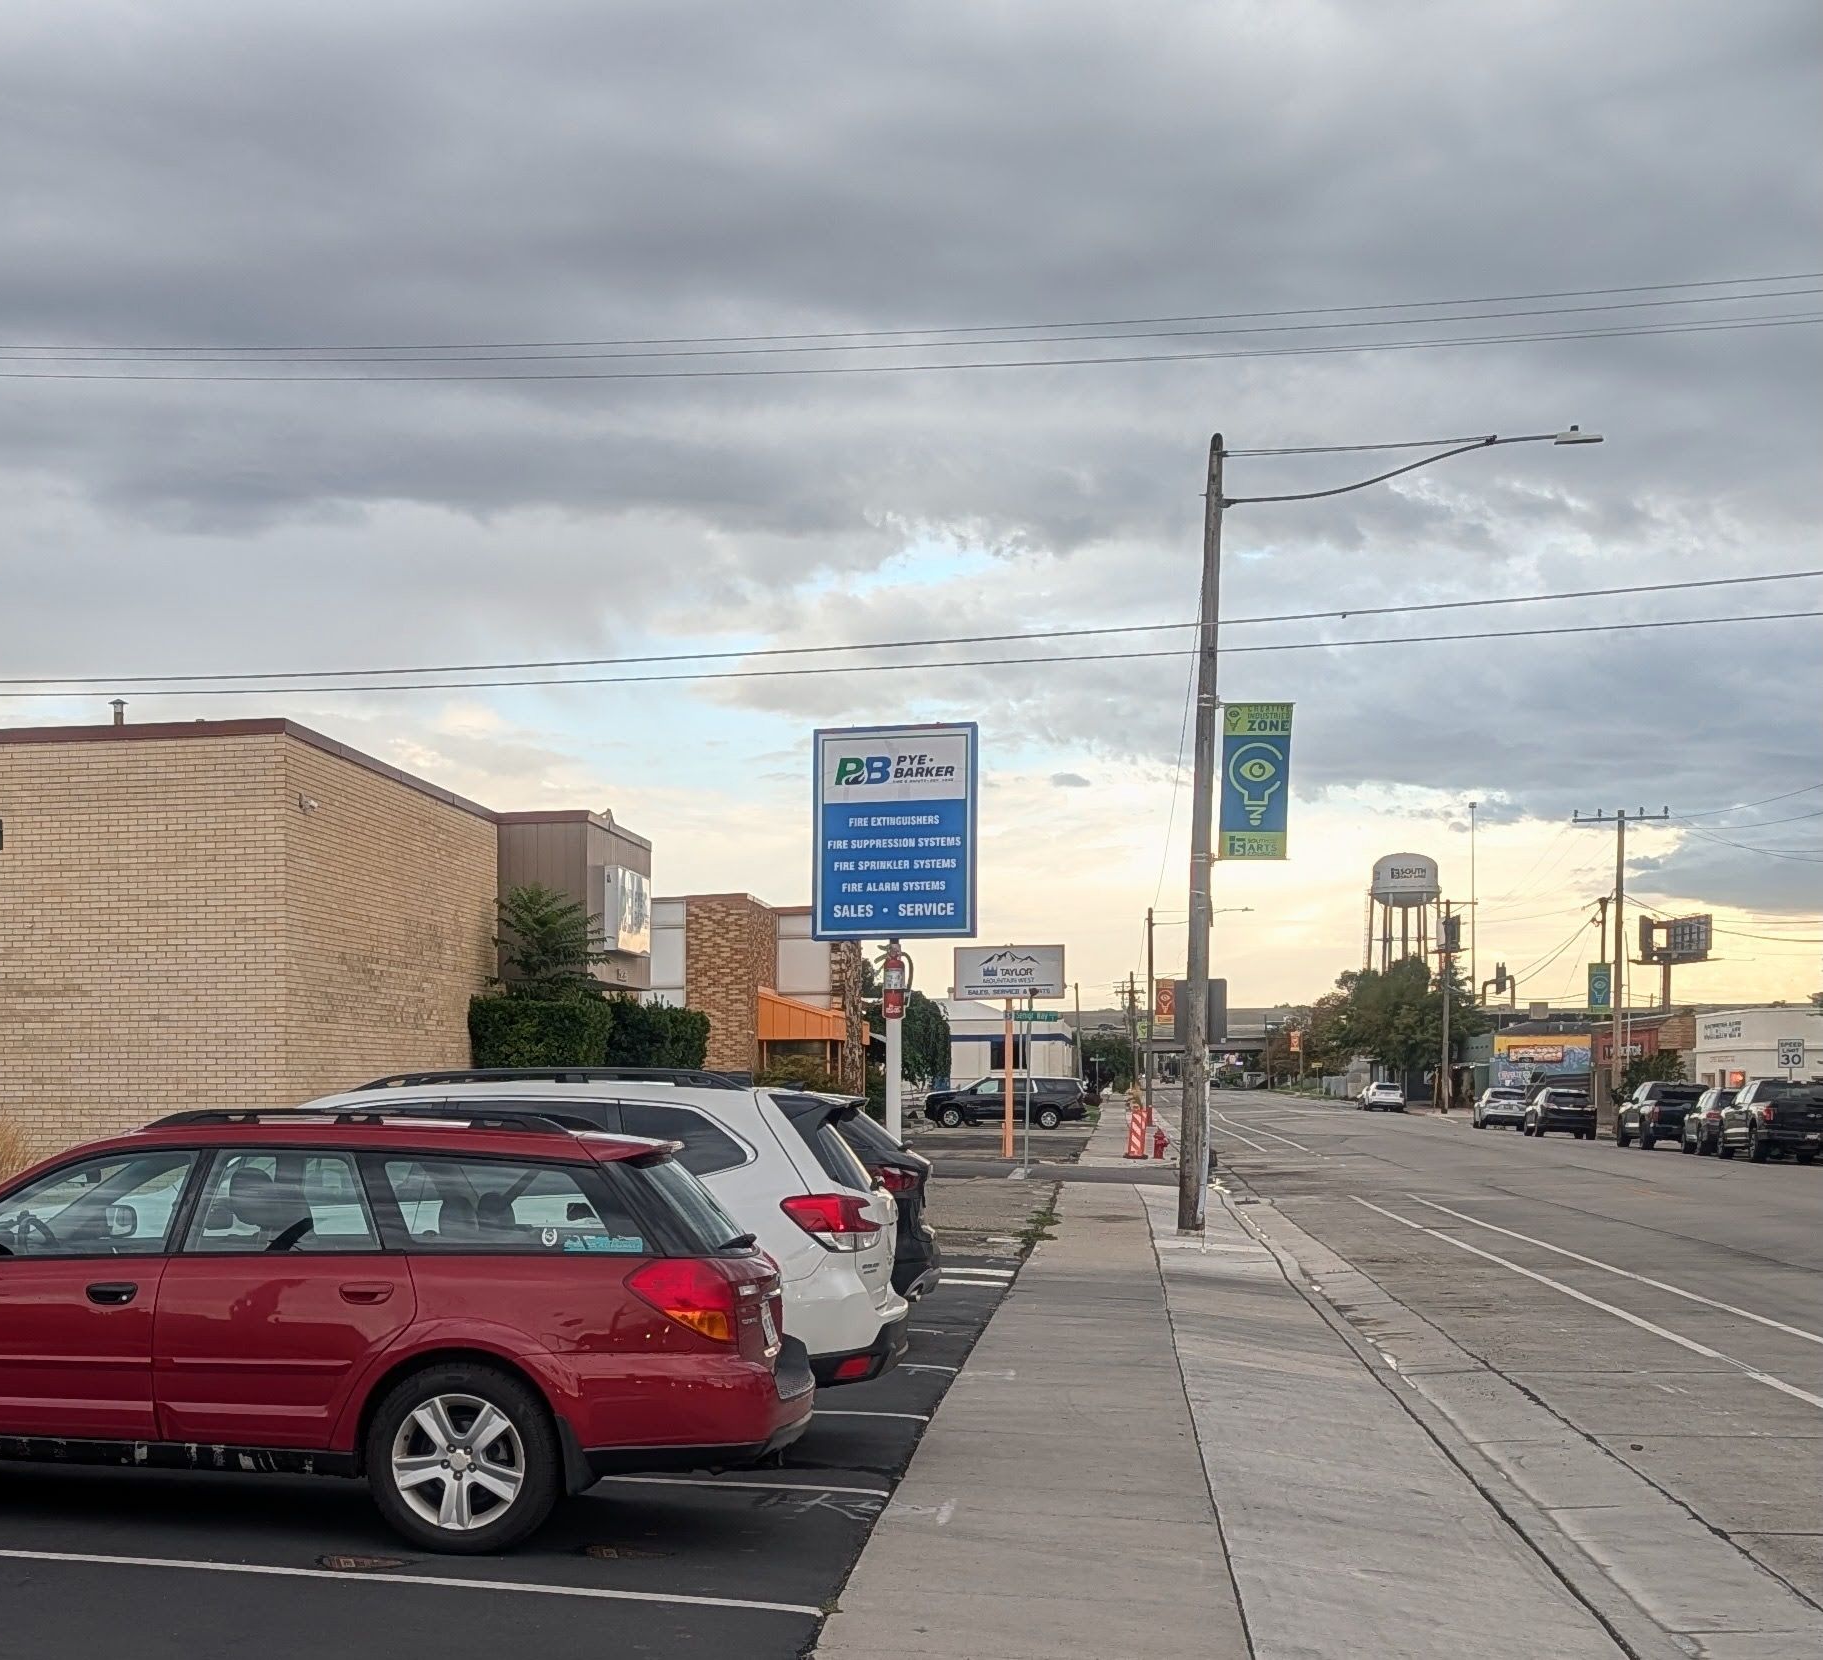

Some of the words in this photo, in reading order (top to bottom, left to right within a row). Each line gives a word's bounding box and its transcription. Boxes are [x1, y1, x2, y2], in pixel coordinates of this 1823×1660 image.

[1247, 719, 1290, 732] ZONE
[893, 765, 955, 778] BARKER
[849, 817, 869, 827] FIRE
[871, 815, 940, 826] EXTINGUISHERS
[828, 840, 848, 849] FIRE
[851, 838, 916, 849] SUPPRESSION
[918, 836, 961, 847] SYSTEMS
[1248, 843, 1278, 852] ARTS
[834, 861, 855, 871] FIRE
[858, 860, 910, 870] SPRINKLER
[913, 858, 957, 869] SYSTEMS
[842, 883, 863, 892] FIRE
[866, 882, 900, 891] ALARM
[903, 880, 946, 891] SYSTEMS
[833, 904, 874, 917] SALES
[898, 902, 955, 916] SERVICE
[1000, 968, 1033, 977] TAYLOR
[1780, 1053, 1802, 1066] 30
